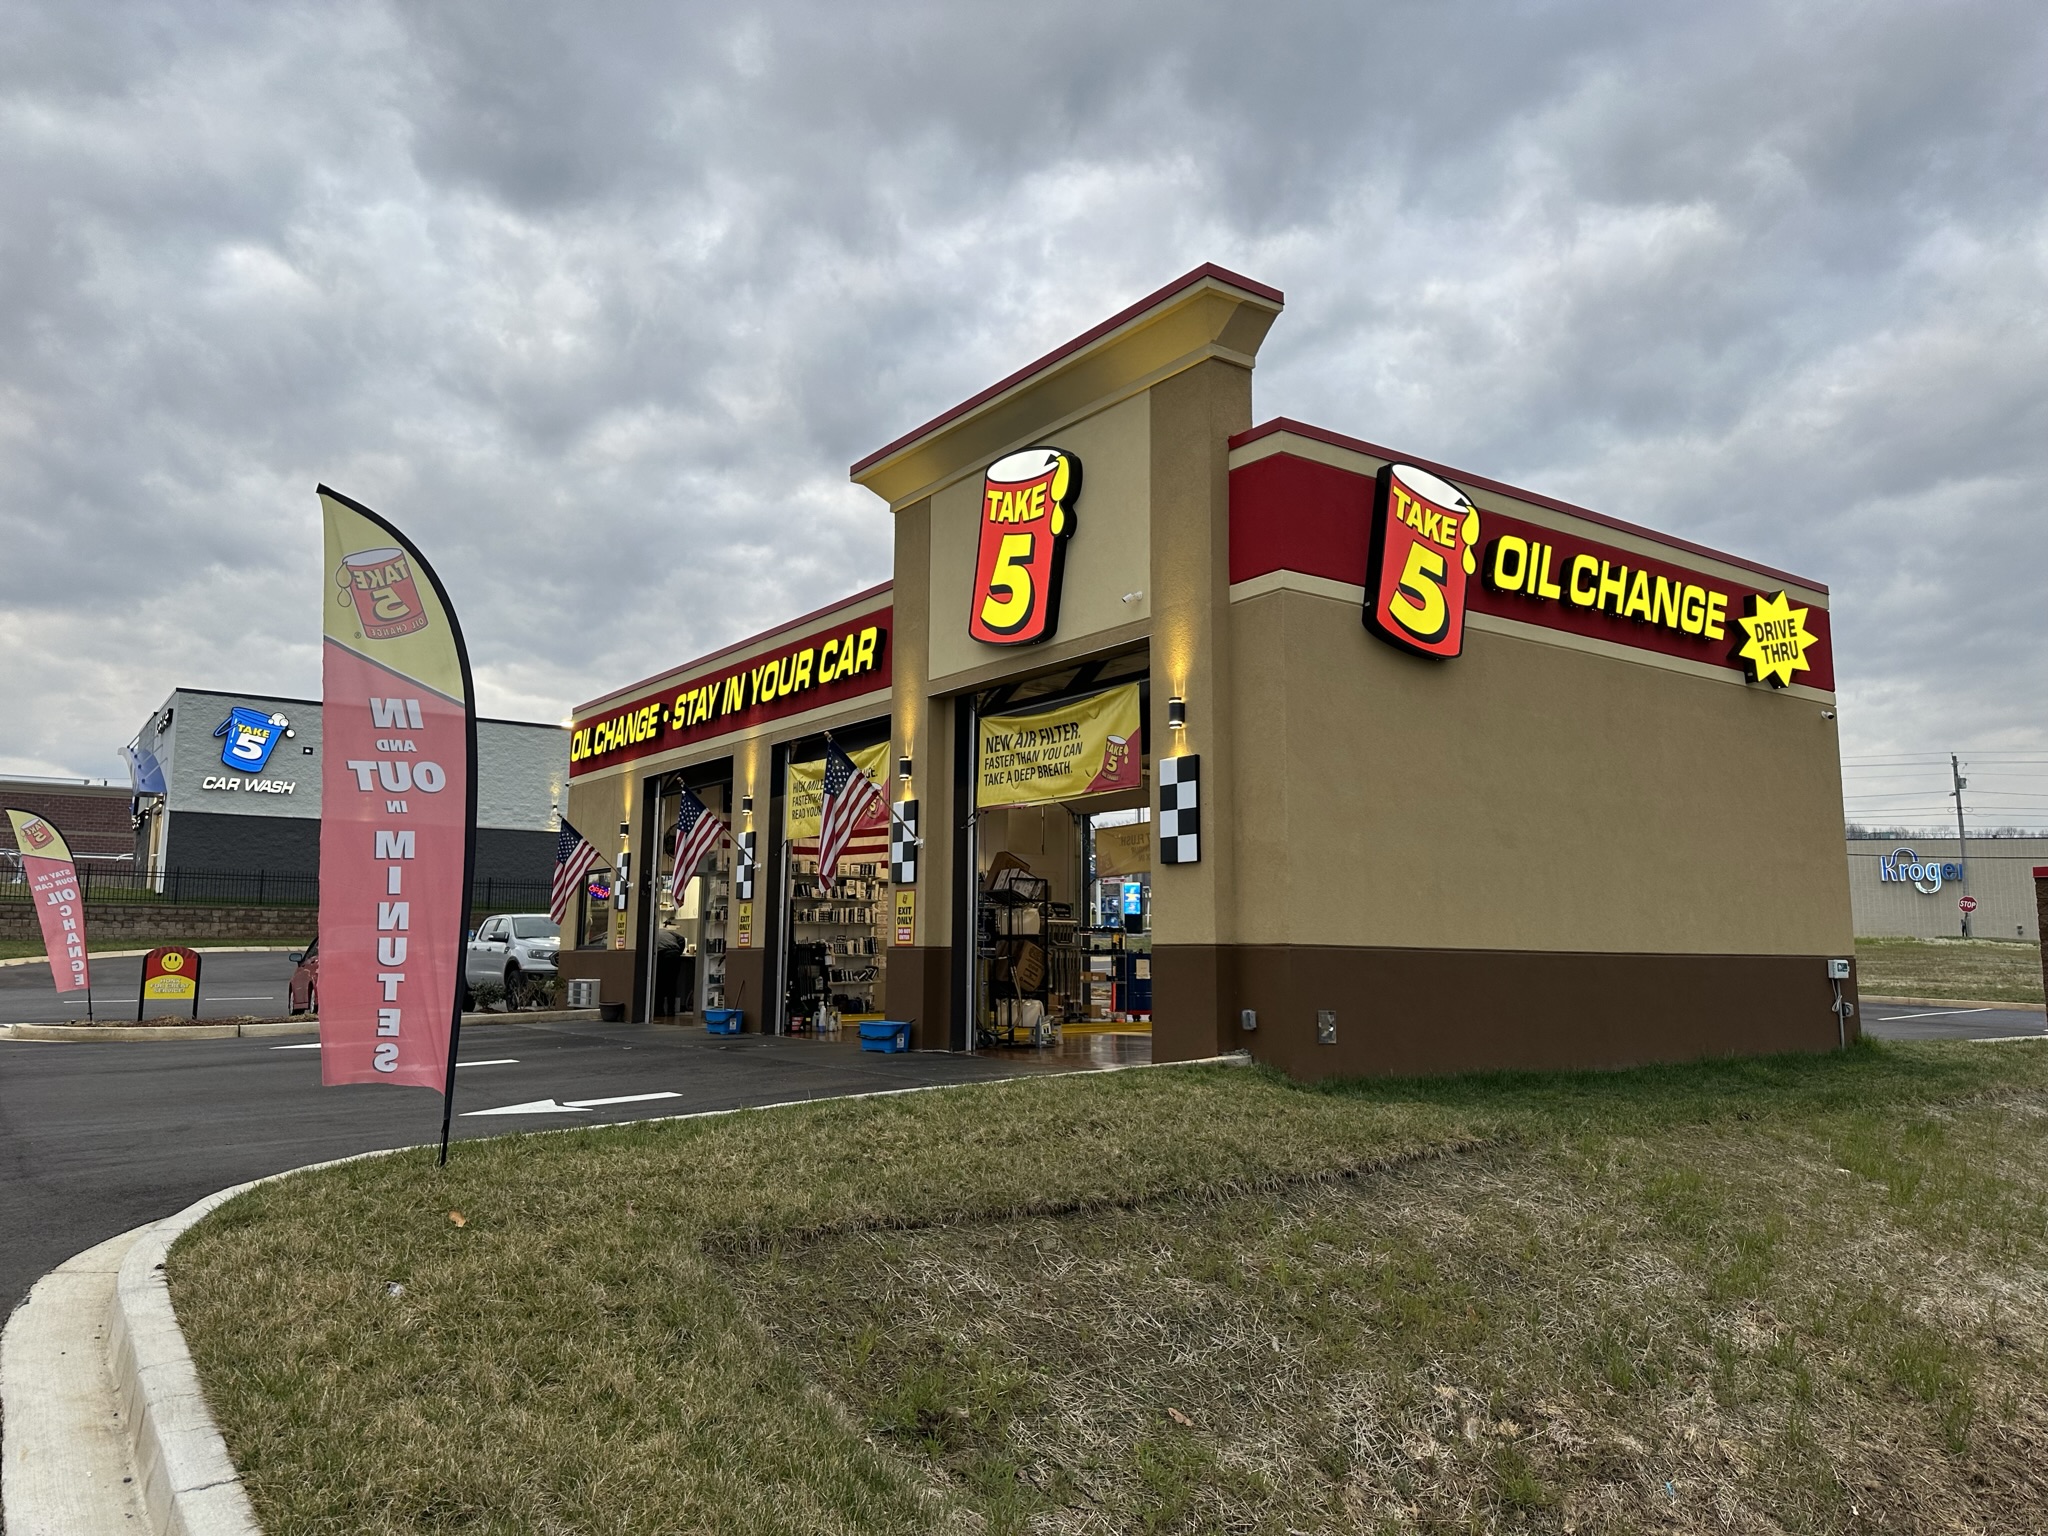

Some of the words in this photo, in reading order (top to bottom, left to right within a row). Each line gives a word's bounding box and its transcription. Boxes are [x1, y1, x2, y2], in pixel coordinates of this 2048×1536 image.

[987, 481, 1047, 523] TAKE
[1392, 485, 1458, 548] TAKE
[981, 533, 1034, 630] 5
[1388, 541, 1446, 637] 5
[1494, 535, 1561, 600] OIL
[1569, 553, 1729, 641] CHANGE
[1754, 618, 1797, 643] DRIVE
[1760, 637, 1799, 666] THRU
[570, 727, 592, 763] OIL
[593, 703, 661, 756] CHANGE
[672, 681, 721, 731] STAY
[721, 672, 747, 716] IN
[751, 648, 815, 705] YOUR
[818, 626, 878, 684] CAR
[238, 724, 271, 739] TAKE
[985, 733, 1014, 754] NEW
[1013, 730, 1037, 750] AIR
[1038, 722, 1081, 746] FILTER.
[232, 733, 266, 760] 5
[984, 754, 1015, 770] FASTER
[1015, 749, 1039, 765] THAN
[1041, 745, 1062, 760] YOU
[1063, 742, 1084, 757] CAN
[1106, 742, 1123, 757] TAKE
[984, 771, 1005, 787] TAKE
[1005, 769, 1013, 784] A
[1014, 766, 1036, 781] DEEP
[1037, 760, 1072, 778] BREATH.
[1105, 755, 1118, 773] 5
[202, 776, 241, 791] CAR
[244, 778, 295, 795] WASH
[588, 884, 611, 898] OPEN
[1959, 900, 1976, 909] STOP
[896, 916, 913, 925] ONLY
[898, 906, 912, 915] EXIT
